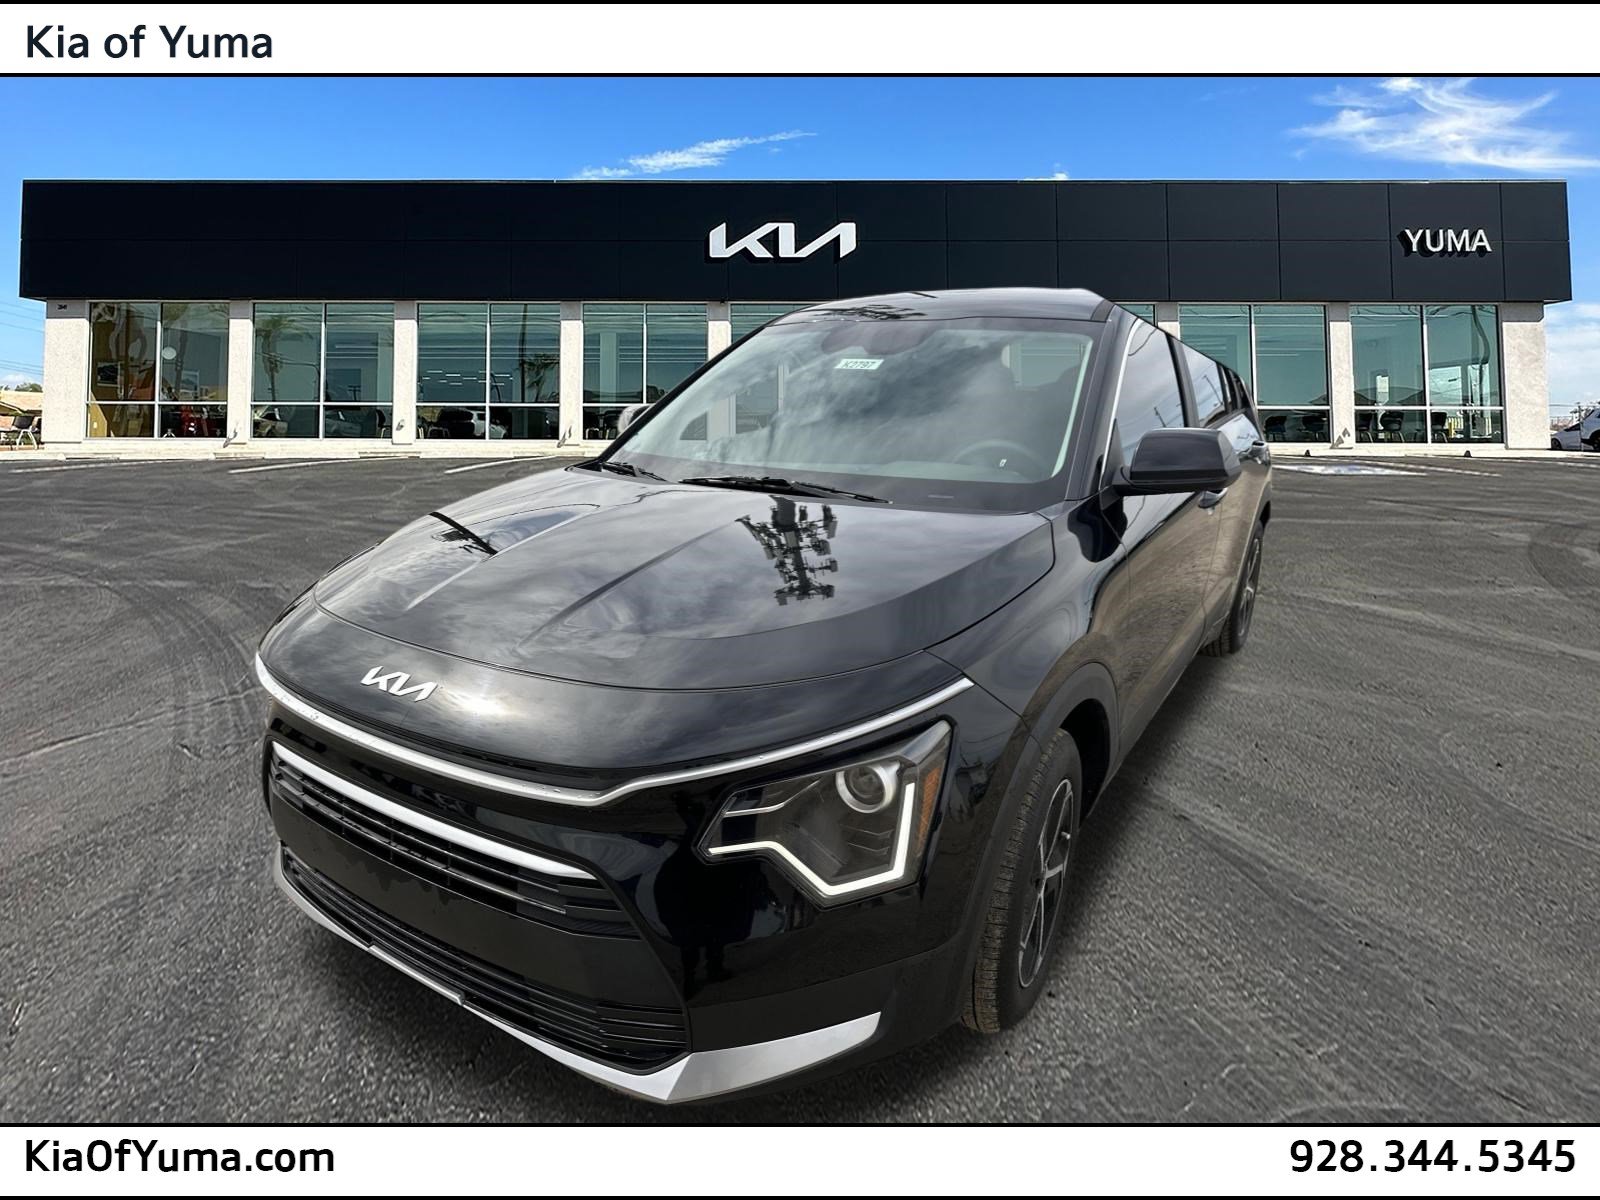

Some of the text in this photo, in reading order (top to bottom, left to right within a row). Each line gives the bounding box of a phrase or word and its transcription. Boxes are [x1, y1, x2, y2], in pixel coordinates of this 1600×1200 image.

[709, 222, 857, 258] KIA
[1404, 228, 1493, 253] YUMA
[361, 665, 438, 702] KIA
